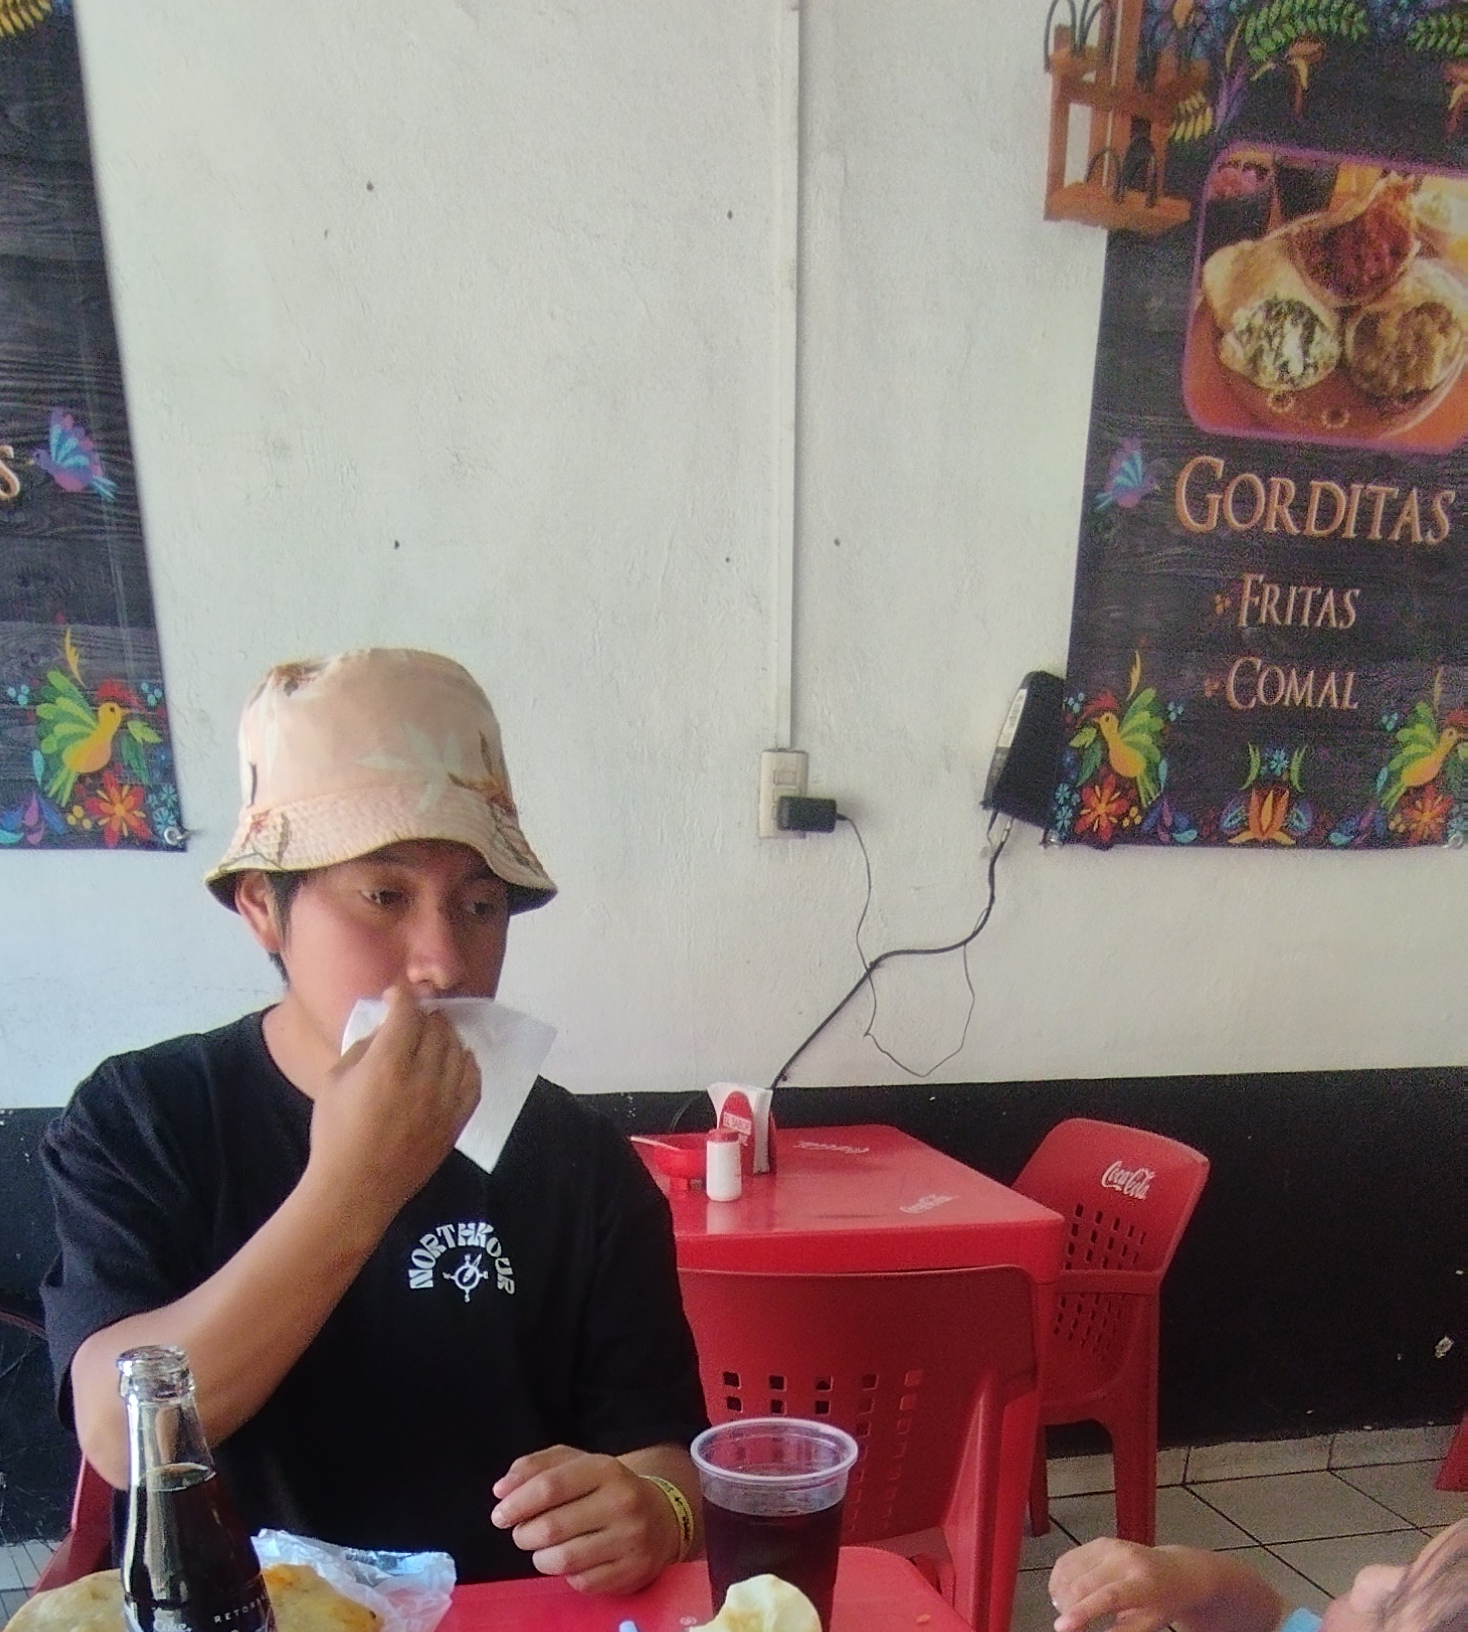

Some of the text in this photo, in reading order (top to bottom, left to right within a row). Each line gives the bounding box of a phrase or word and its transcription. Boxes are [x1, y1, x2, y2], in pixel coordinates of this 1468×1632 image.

[1174, 455, 1456, 545] GORDITAS
[1237, 572, 1362, 629] FRITAS
[1226, 656, 1359, 710] COMAL
